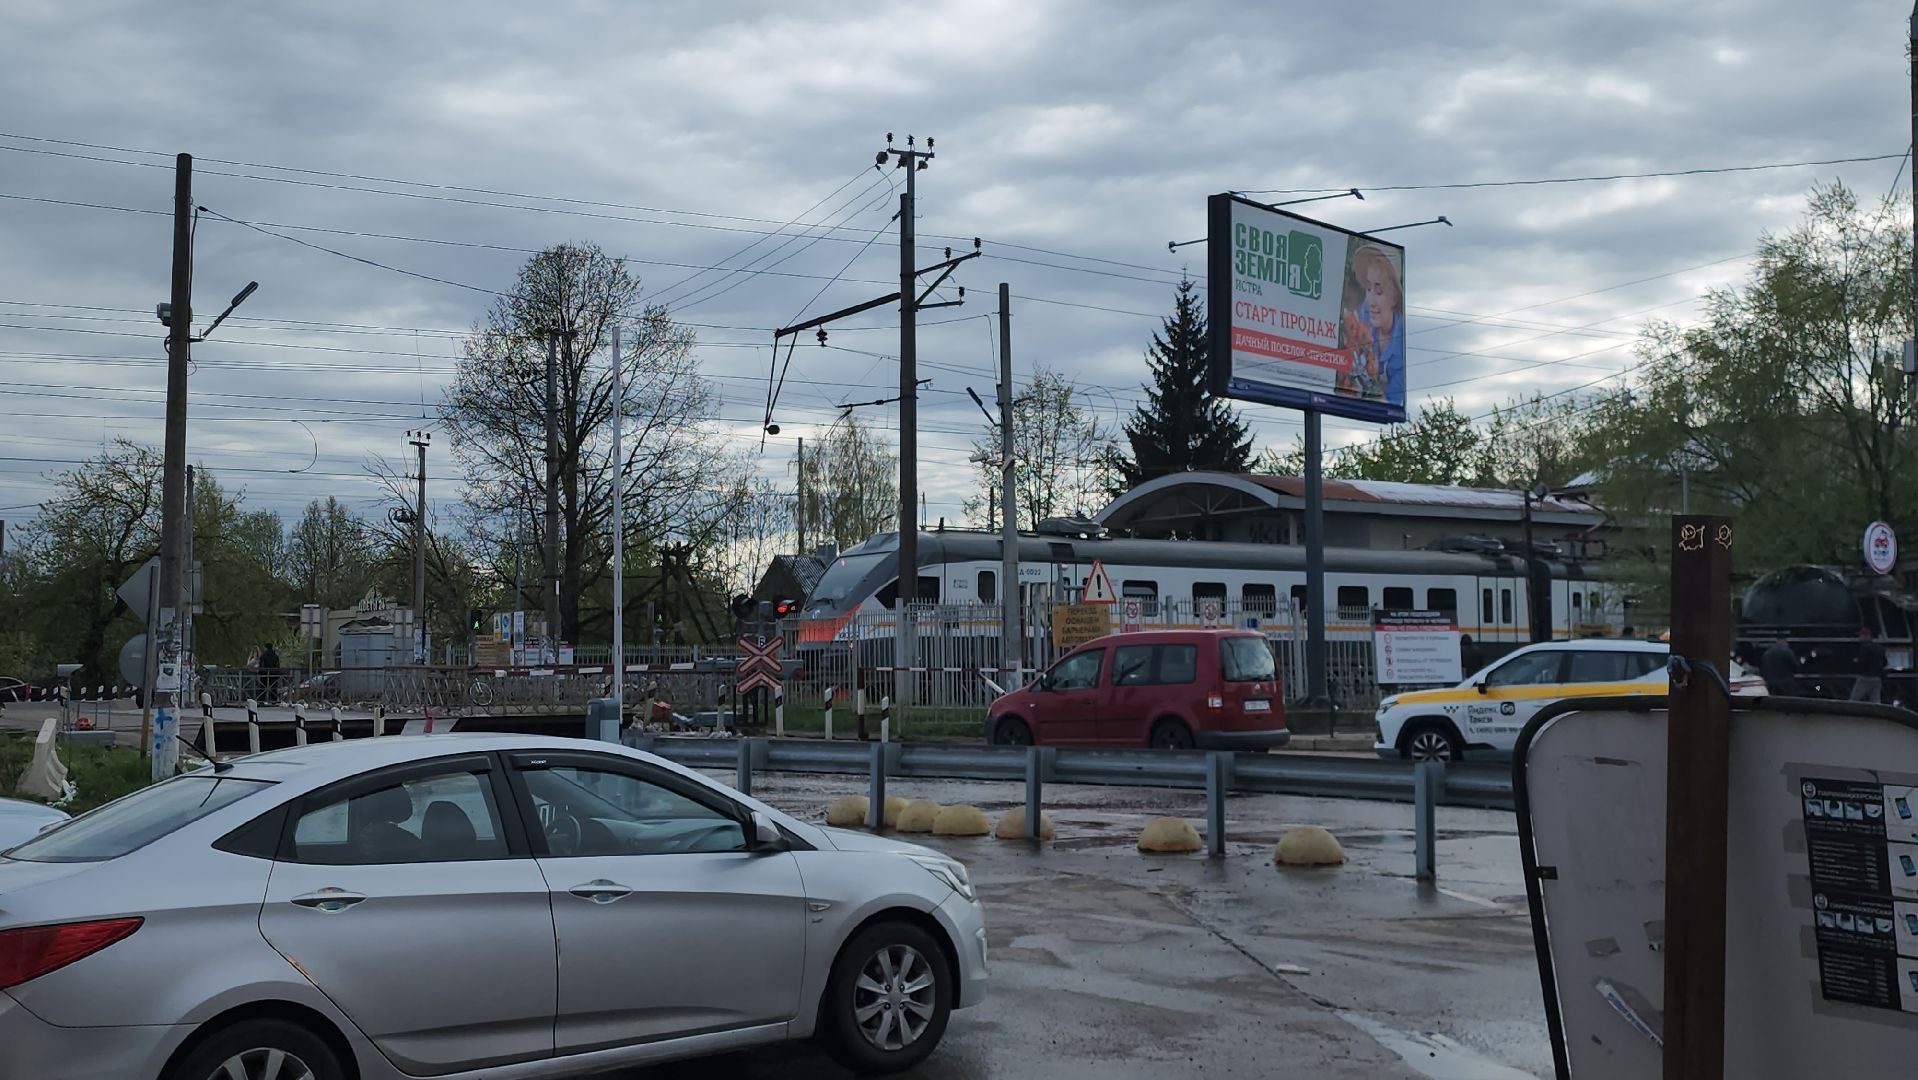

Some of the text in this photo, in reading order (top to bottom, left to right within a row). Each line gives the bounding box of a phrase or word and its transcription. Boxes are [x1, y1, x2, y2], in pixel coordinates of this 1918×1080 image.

[1235, 222, 1287, 259] СВОЯ
[1235, 250, 1300, 290] ЗЕМЛЯ
[1235, 278, 1263, 296] ИСТРА
[1235, 300, 1337, 339] СТАРТ ПРОДАЖ
[1235, 333, 1270, 351] ДАЧНЫЙ
[1271, 340, 1306, 357] ПОСЕЛОК
